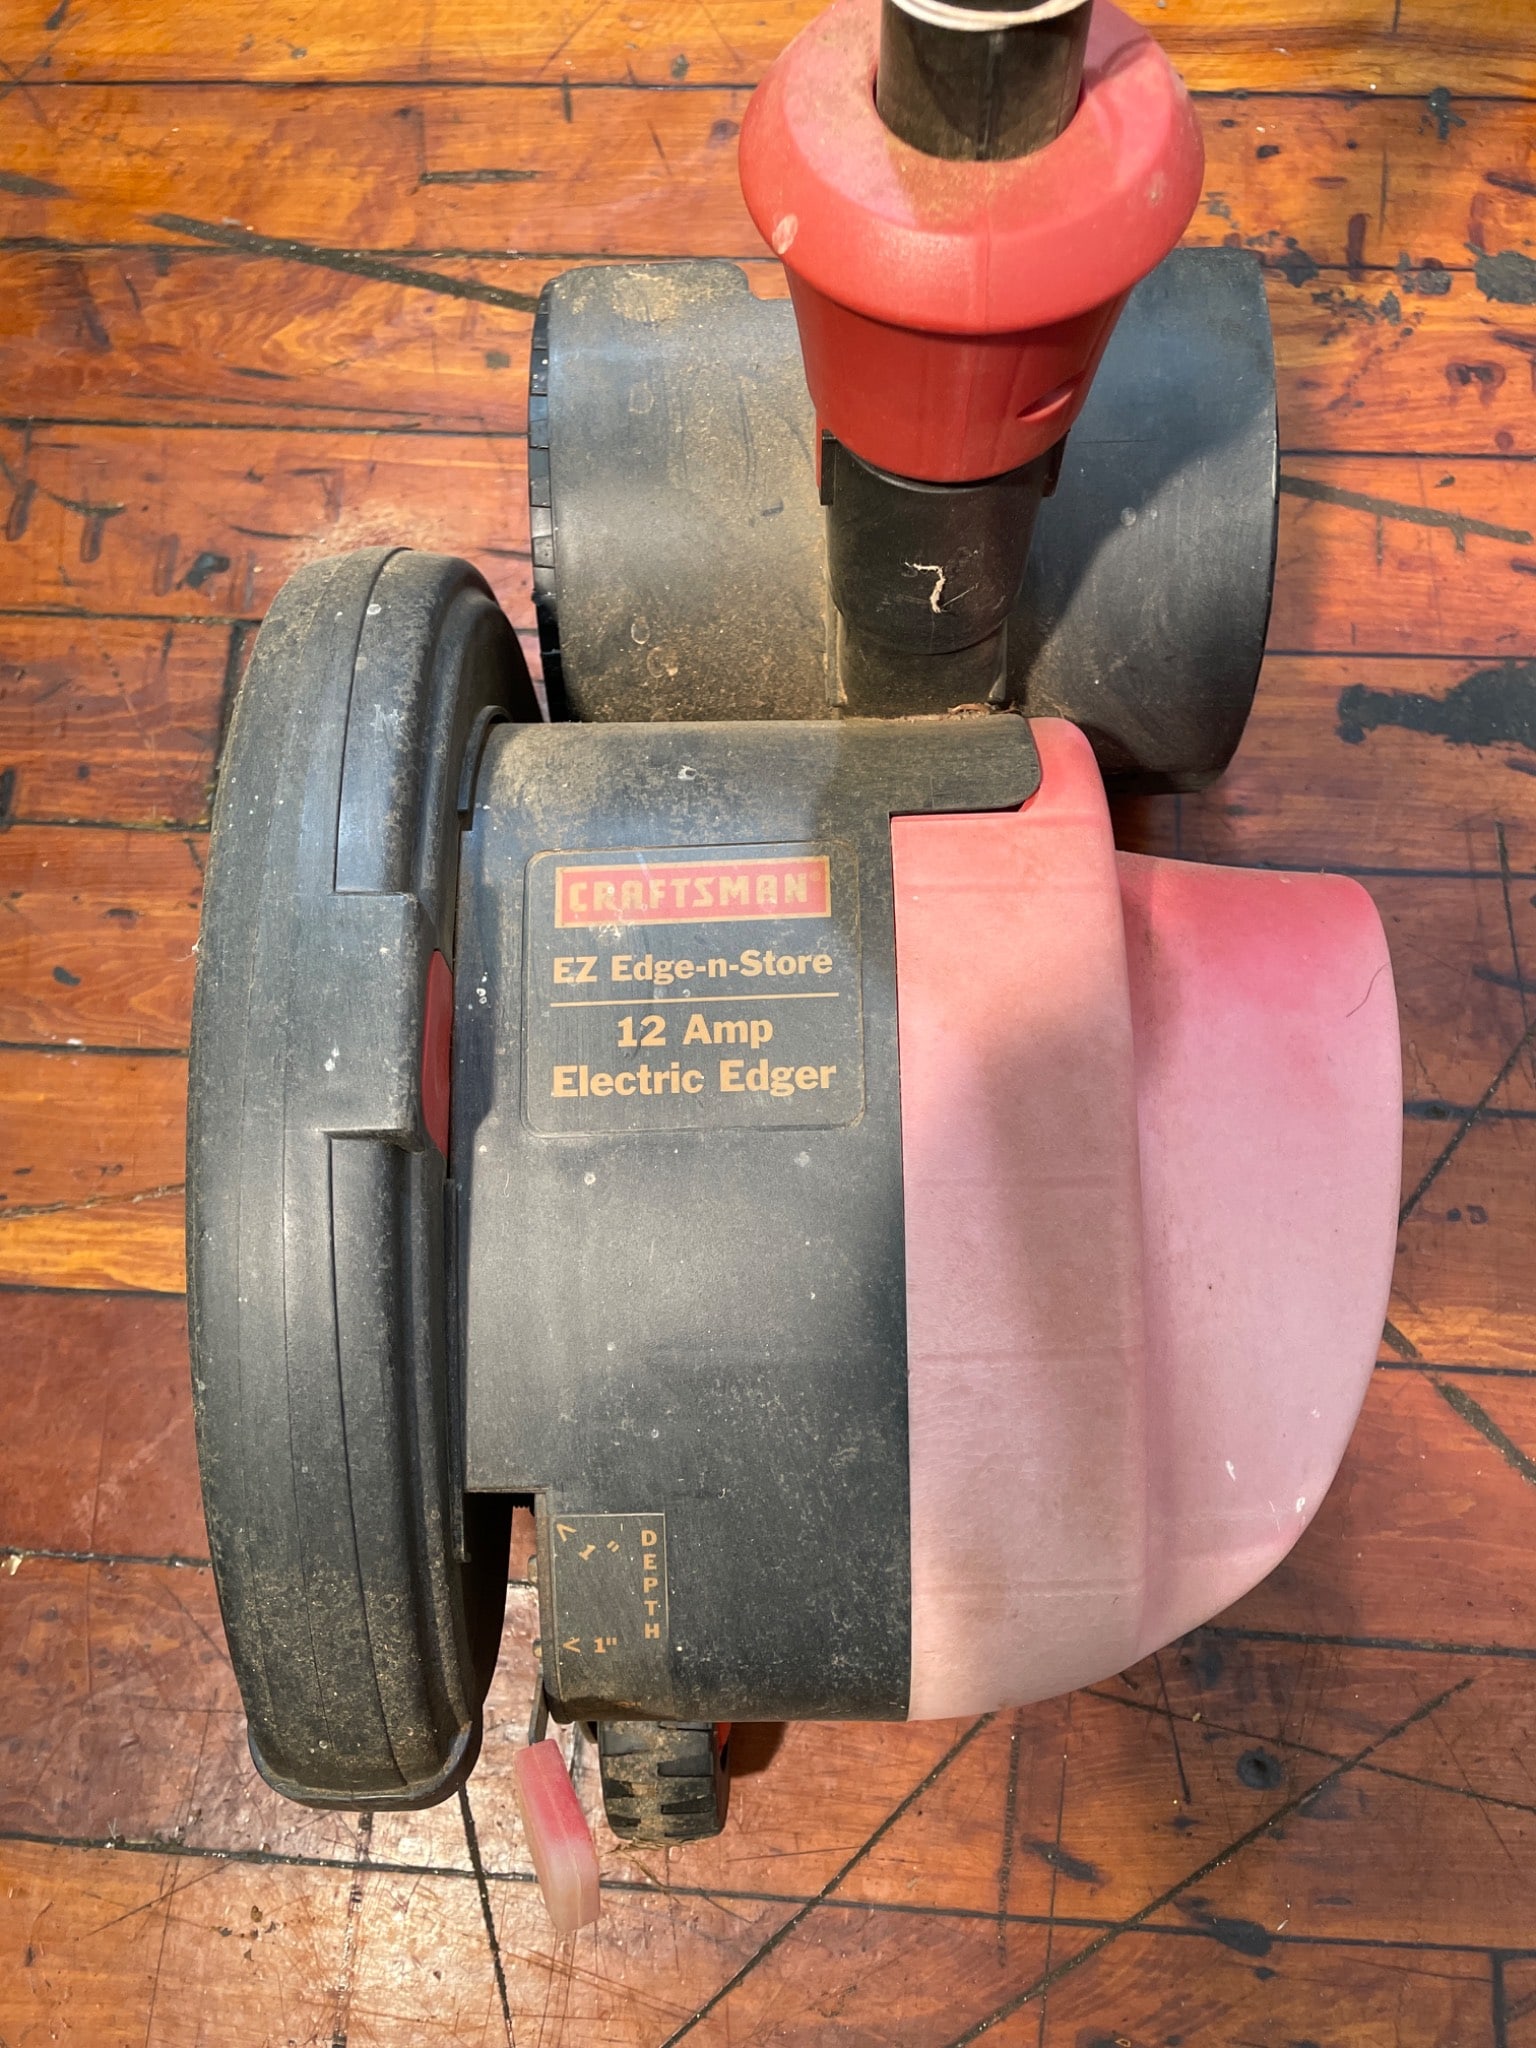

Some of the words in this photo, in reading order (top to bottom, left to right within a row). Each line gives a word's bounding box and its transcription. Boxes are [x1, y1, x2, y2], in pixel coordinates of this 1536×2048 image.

[568, 872, 807, 912] CRAFTSMAN
[553, 956, 598, 984] EZ
[611, 949, 834, 985] Edge-n-Store
[617, 1015, 666, 1047] 12
[682, 1013, 774, 1049] Amp
[552, 1062, 704, 1097] Electric
[719, 1058, 837, 1097] Edger
[641, 1529, 661, 1640] DEPTH
